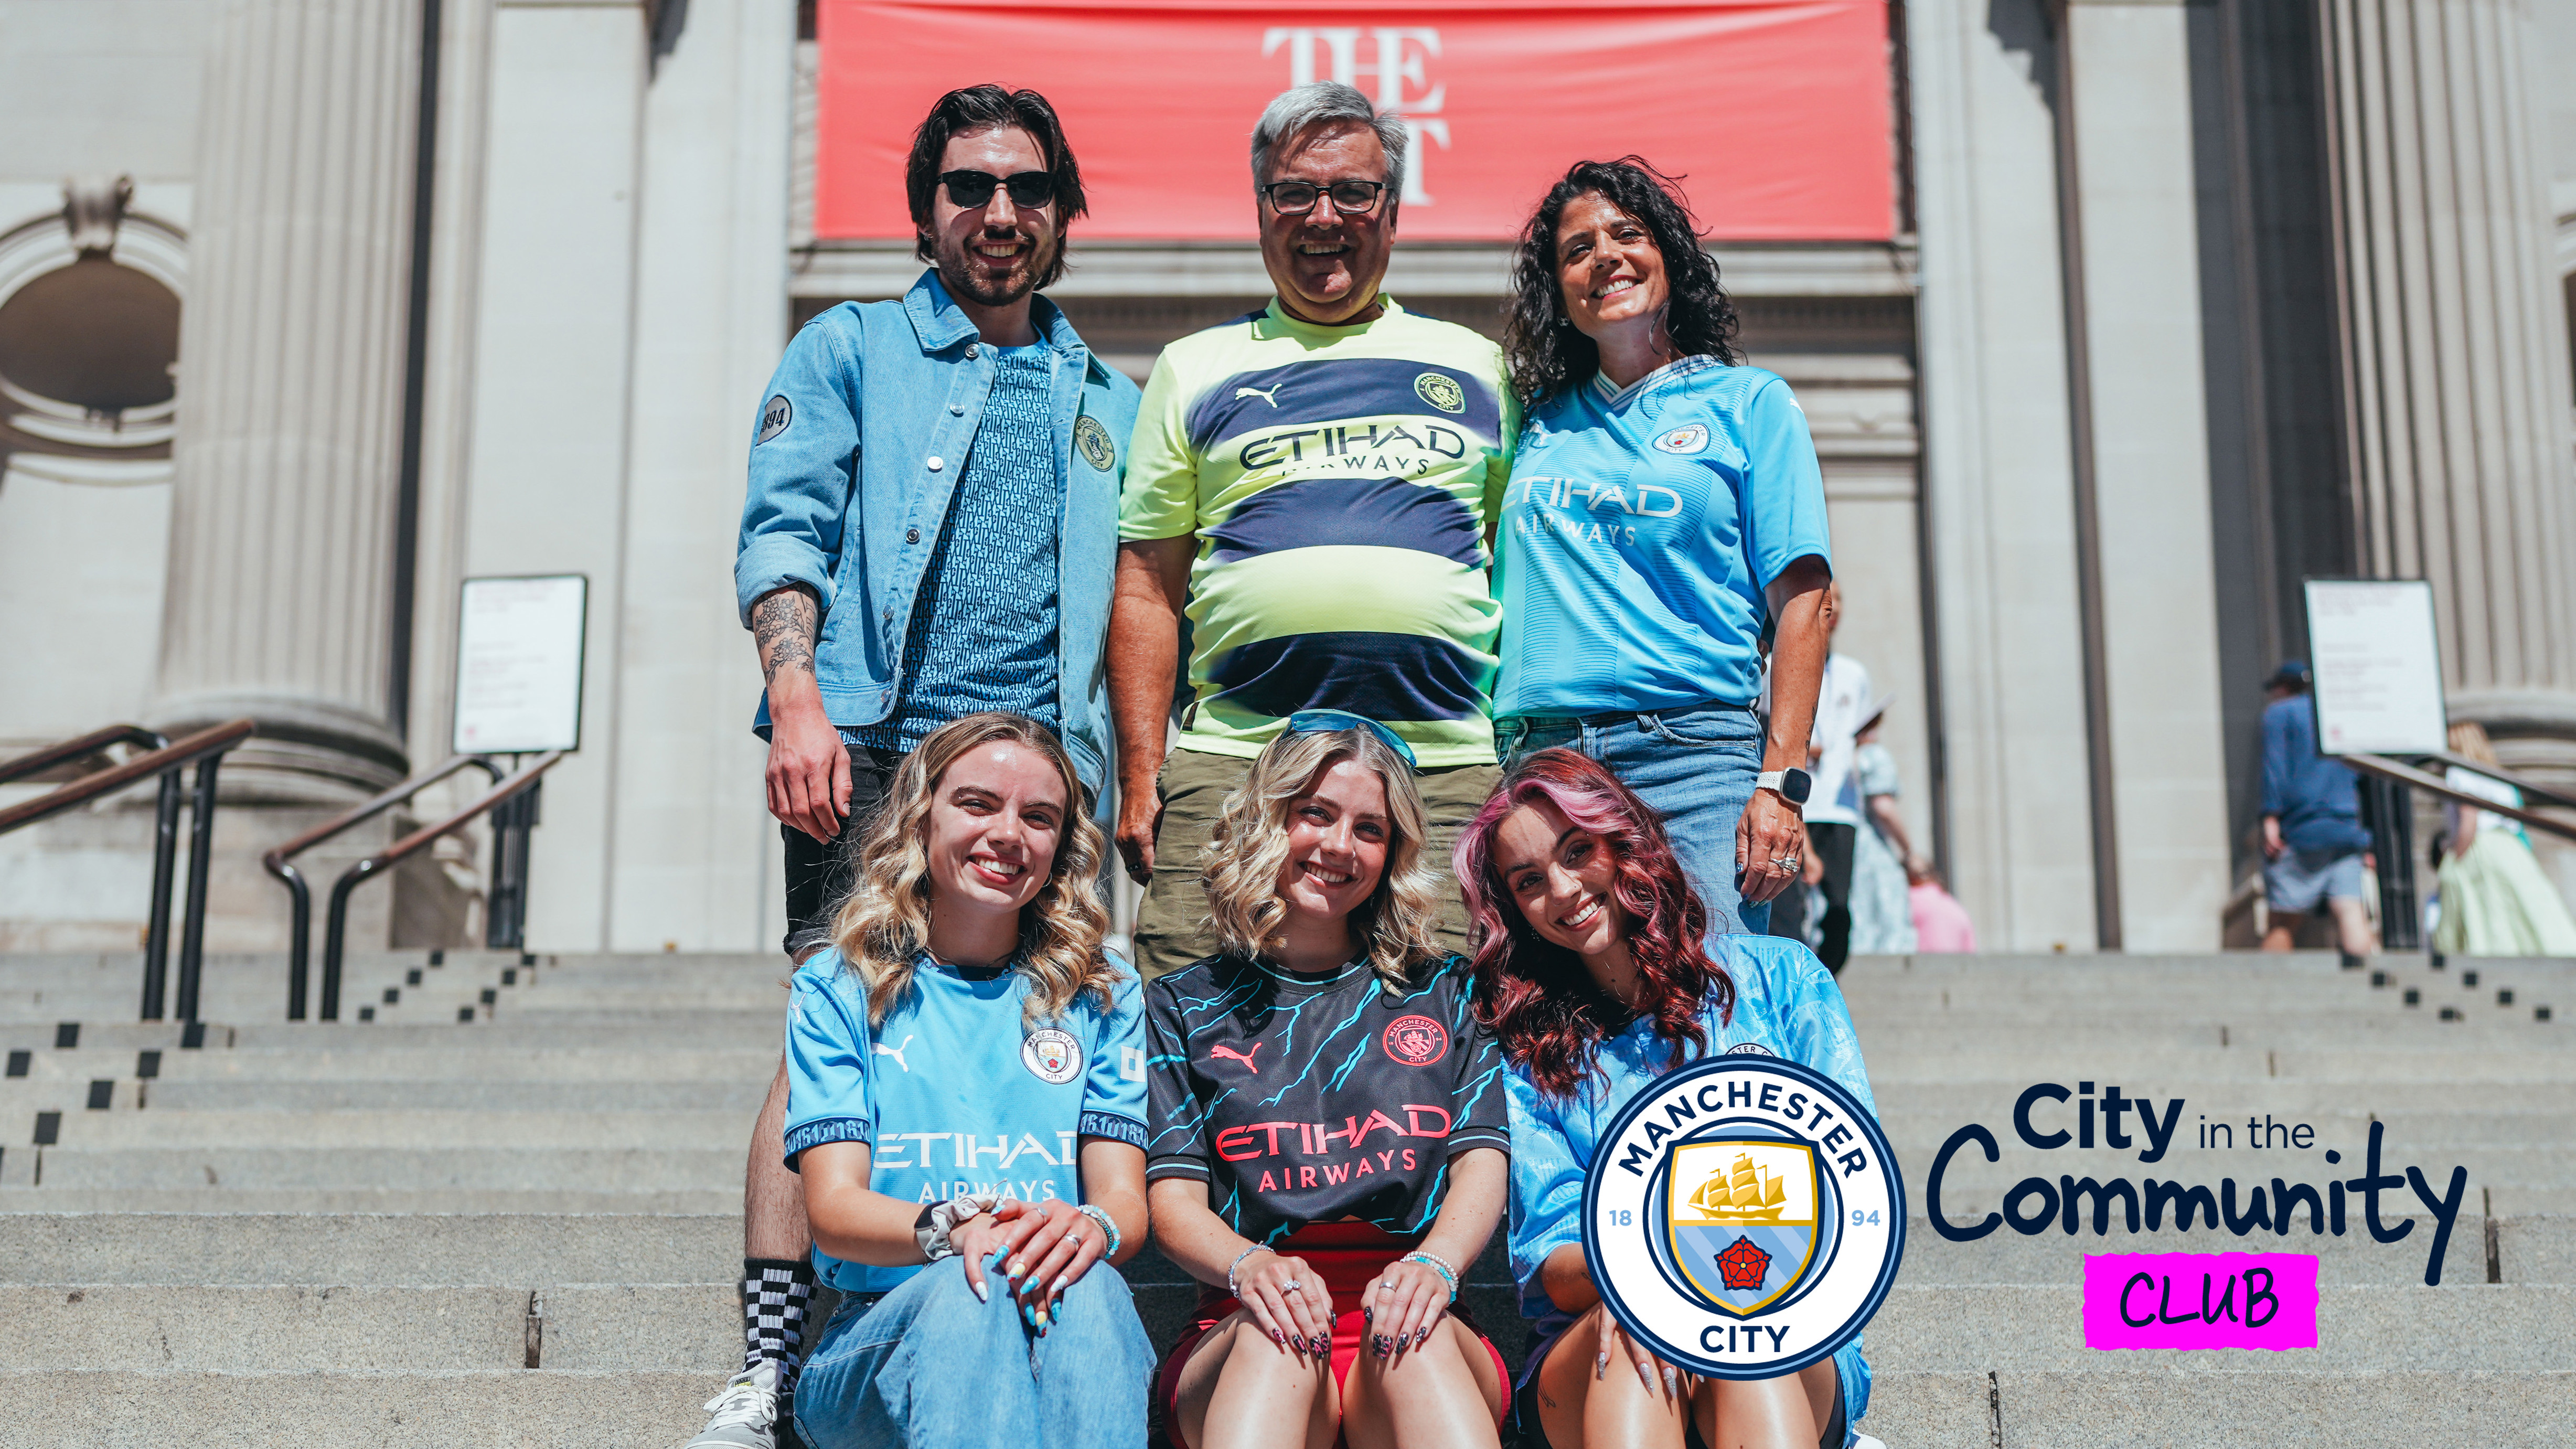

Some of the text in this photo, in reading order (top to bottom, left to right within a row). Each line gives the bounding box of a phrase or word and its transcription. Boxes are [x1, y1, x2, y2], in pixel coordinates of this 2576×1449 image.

[1262, 27, 1445, 112] THE
[1239, 425, 1465, 471] ETIHAD
[1516, 514, 1636, 546] AIRWAYS
[1389, 1019, 1438, 1037] MANCHESTER
[1215, 1104, 1451, 1162] ETIHAD
[1258, 1148, 1416, 1193] AIRWAYS
